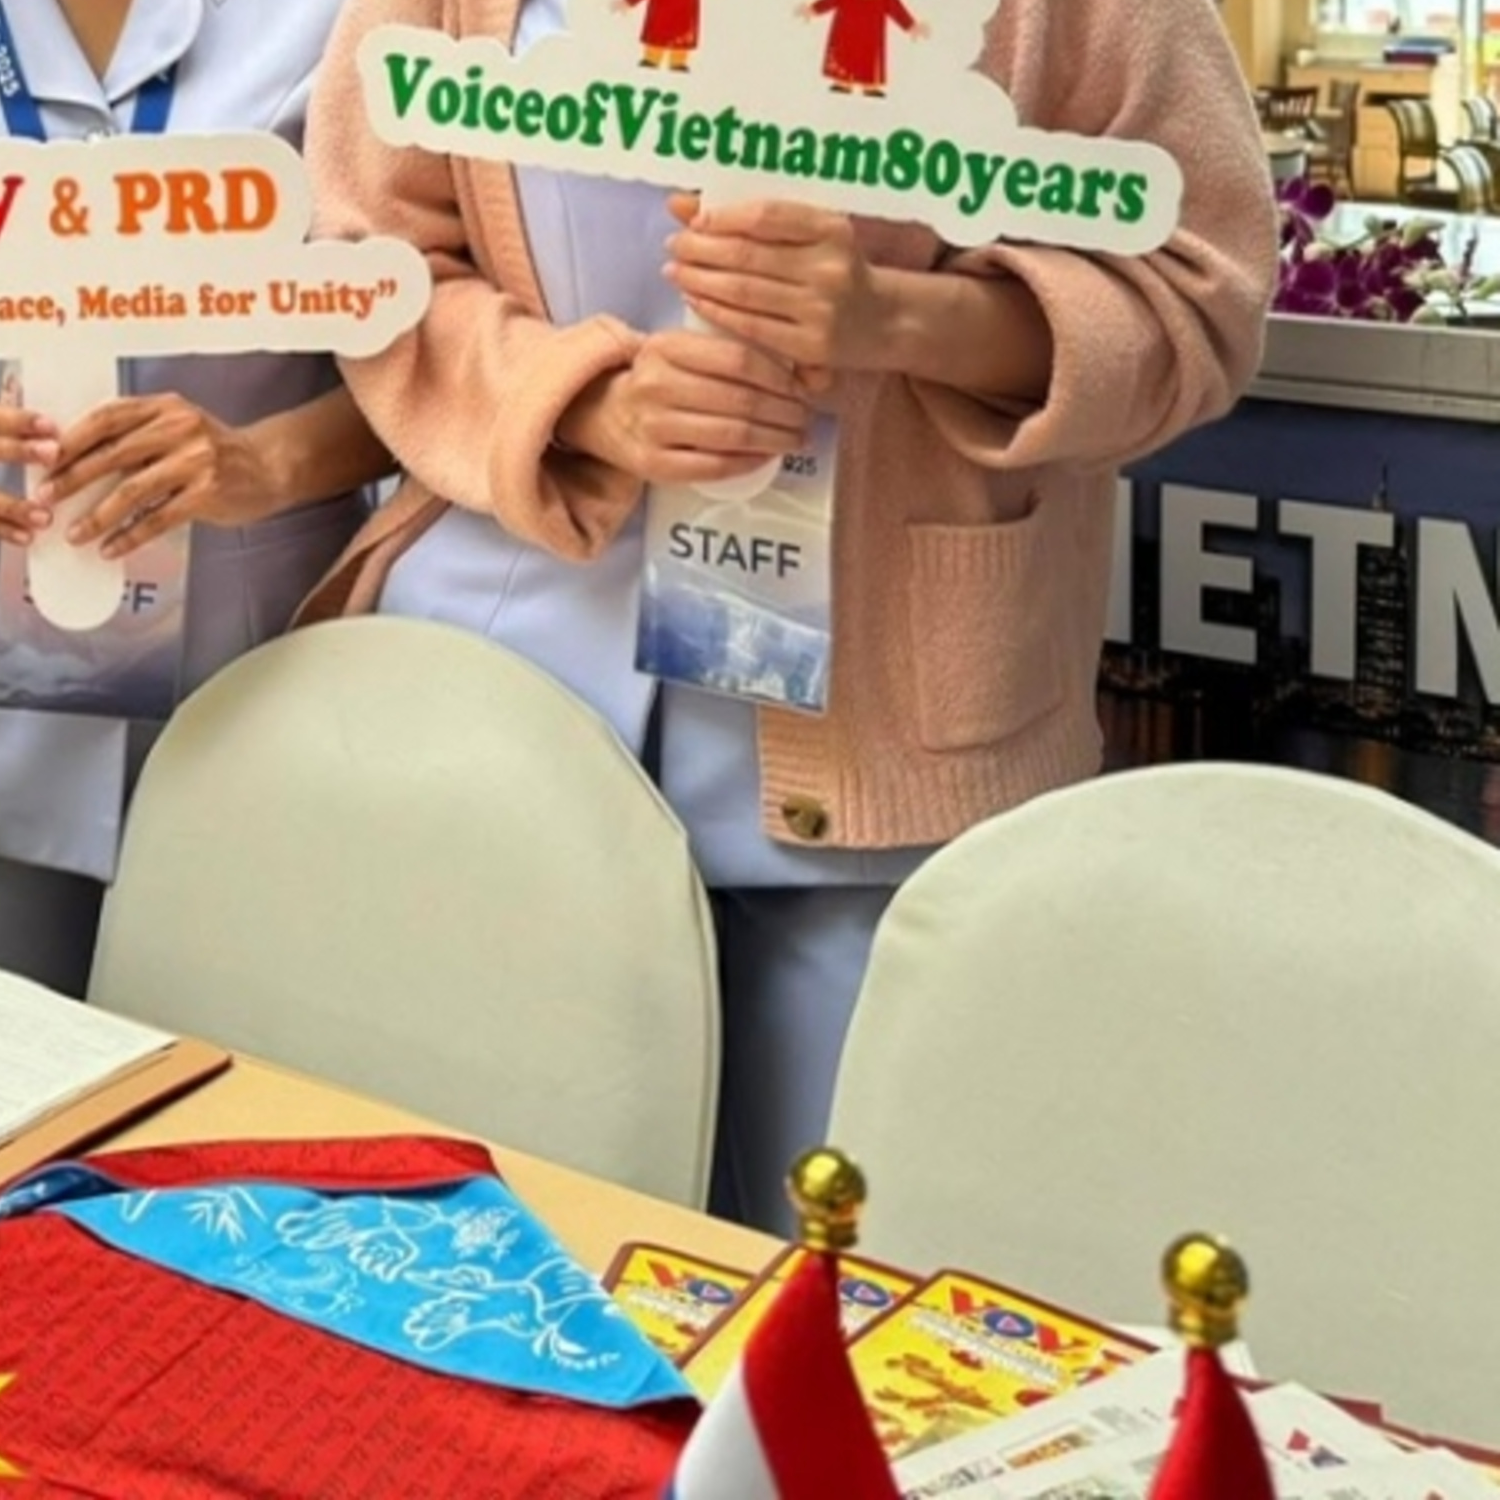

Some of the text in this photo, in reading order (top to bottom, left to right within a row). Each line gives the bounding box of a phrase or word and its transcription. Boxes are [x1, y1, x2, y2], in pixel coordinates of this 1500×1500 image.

[385, 53, 1148, 223] VoiceofVietnam80years
[48, 176, 90, 238] &
[113, 166, 280, 237] PRD
[76, 284, 189, 321] Media
[196, 282, 259, 318] for
[266, 278, 399, 321] Unity”
[668, 522, 802, 579] STAFF
